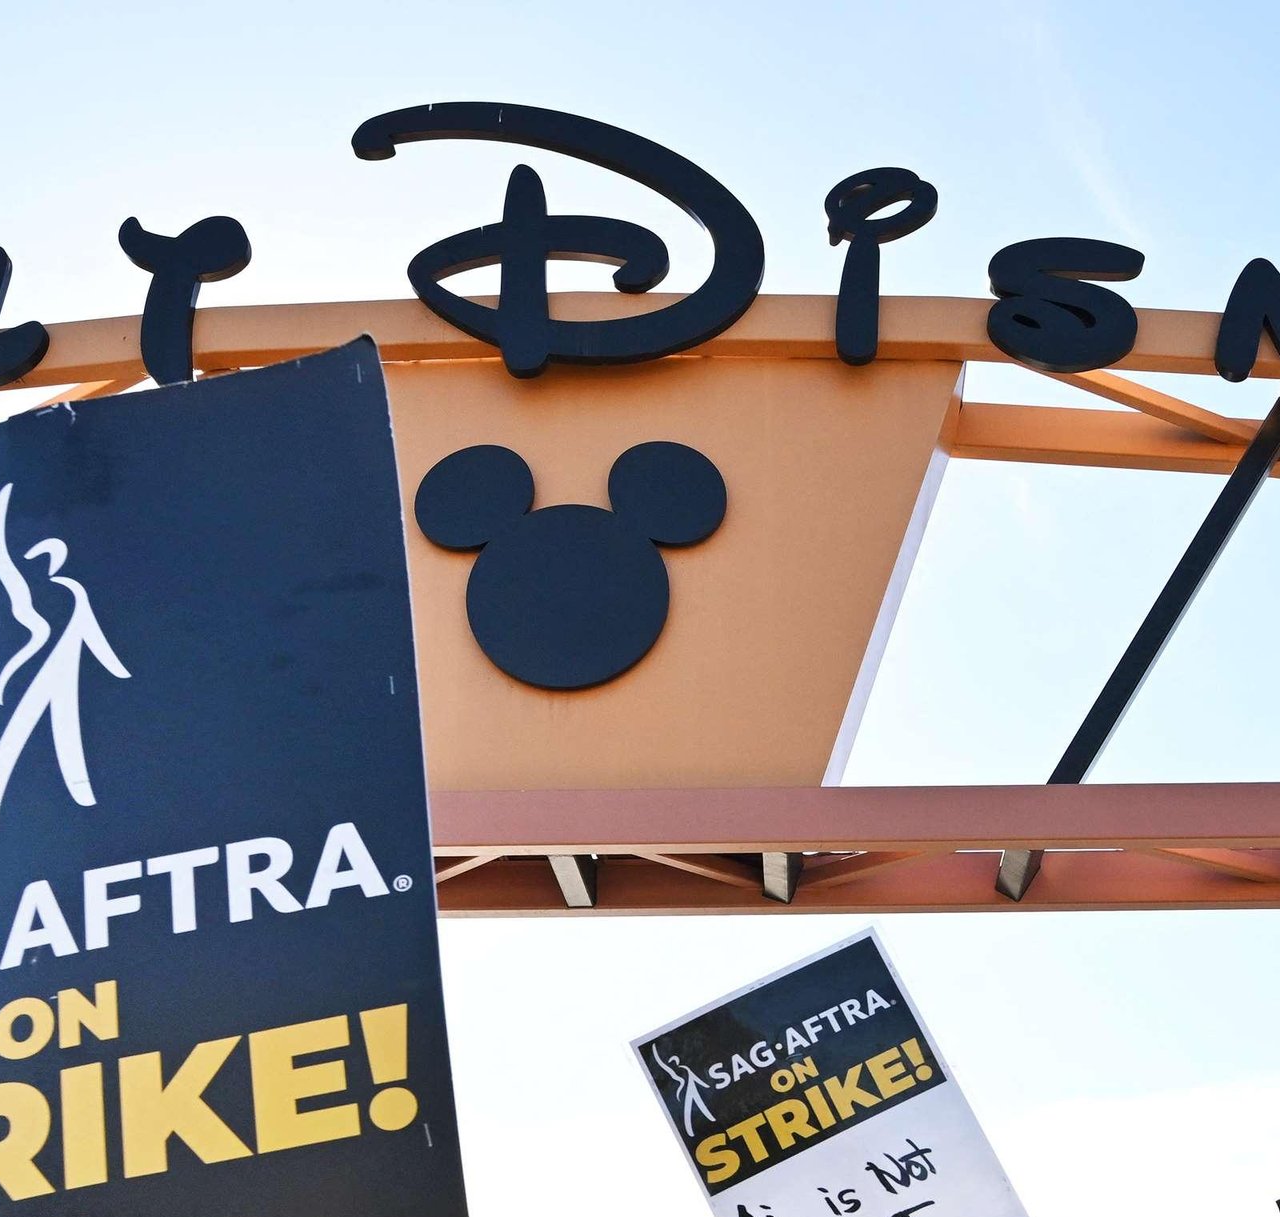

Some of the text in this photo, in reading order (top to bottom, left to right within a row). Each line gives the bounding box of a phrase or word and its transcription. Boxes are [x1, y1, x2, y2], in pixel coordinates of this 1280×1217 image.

[770, 1056, 819, 1093] ON
[694, 1037, 934, 1184] STRIKE!
[817, 1186, 863, 1216] is
